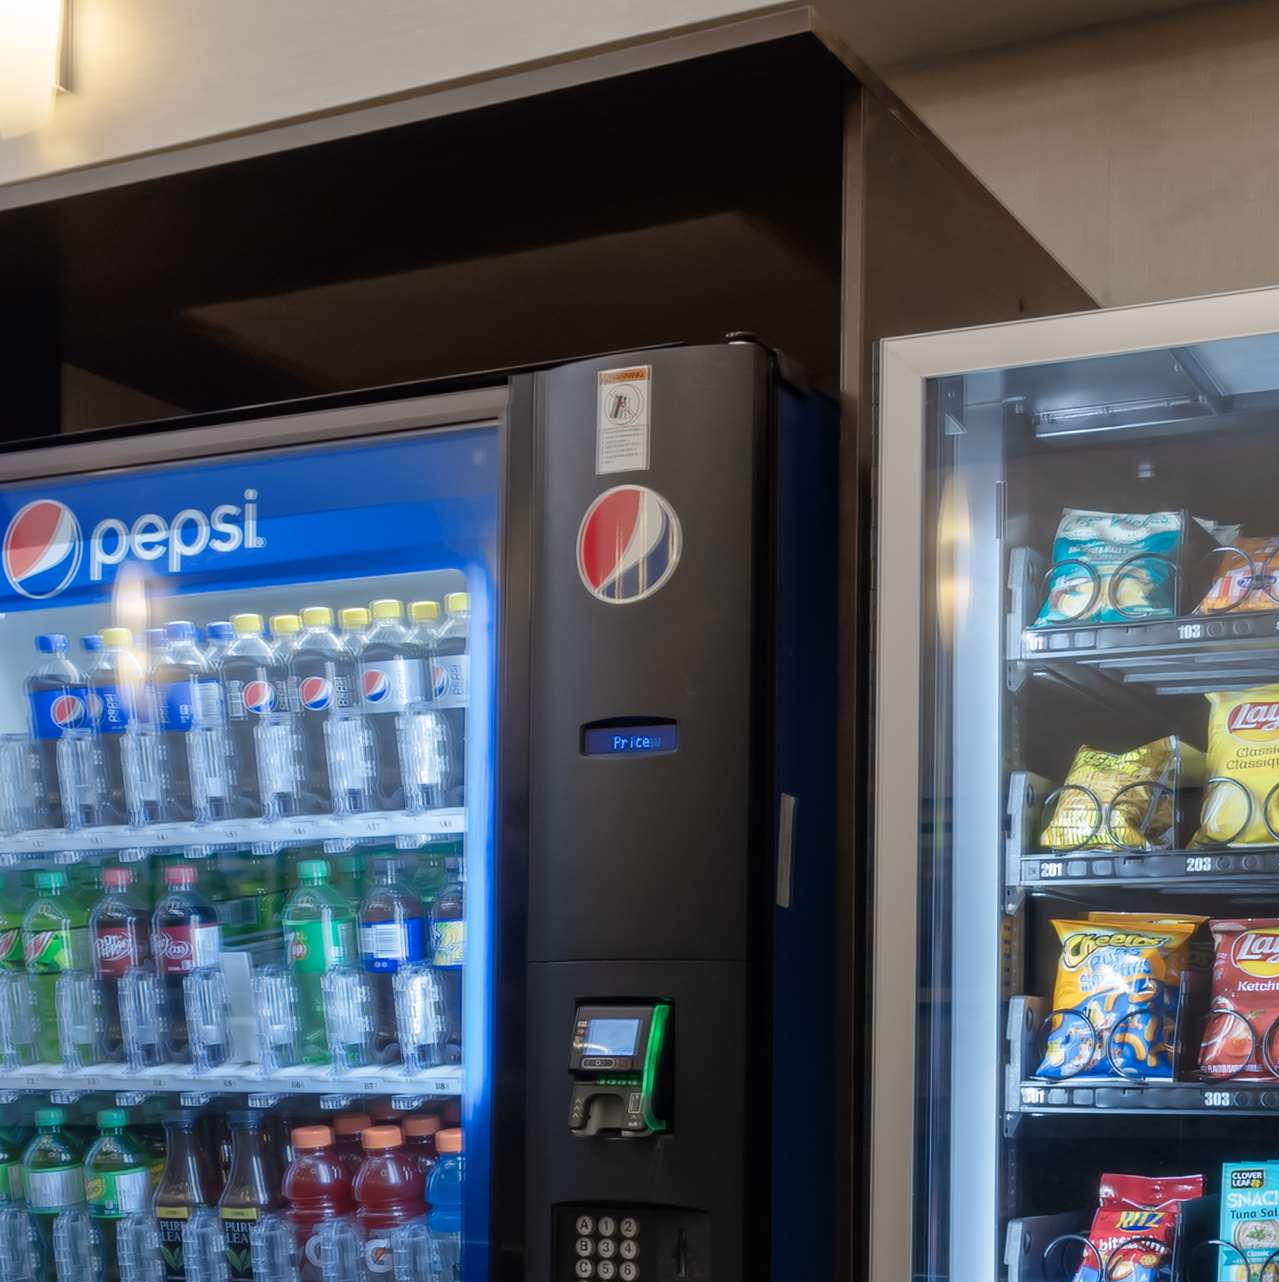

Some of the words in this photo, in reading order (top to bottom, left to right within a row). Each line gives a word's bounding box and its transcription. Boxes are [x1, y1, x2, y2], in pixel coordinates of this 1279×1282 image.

[89, 488, 257, 581] pepsi
[1177, 625, 1201, 640] 103
[613, 735, 650, 749] Price
[1040, 863, 1063, 878] 201
[1186, 857, 1212, 872] 203
[1204, 1092, 1230, 1107] 303
[1231, 1172, 1262, 1181] CLOVER
[1231, 1180, 1252, 1188] LEAF
[1116, 1210, 1166, 1229] RITZ
[1230, 1209, 1257, 1220] Tuna
[580, 1219, 589, 1229] A
[603, 1220, 609, 1230] 1
[624, 1221, 632, 1232] 2
[580, 1240, 588, 1251] B
[602, 1242, 609, 1253] 3
[624, 1243, 632, 1253] 4
[579, 1262, 588, 1273] C
[602, 1263, 609, 1274] 5
[624, 1264, 632, 1276] 6
